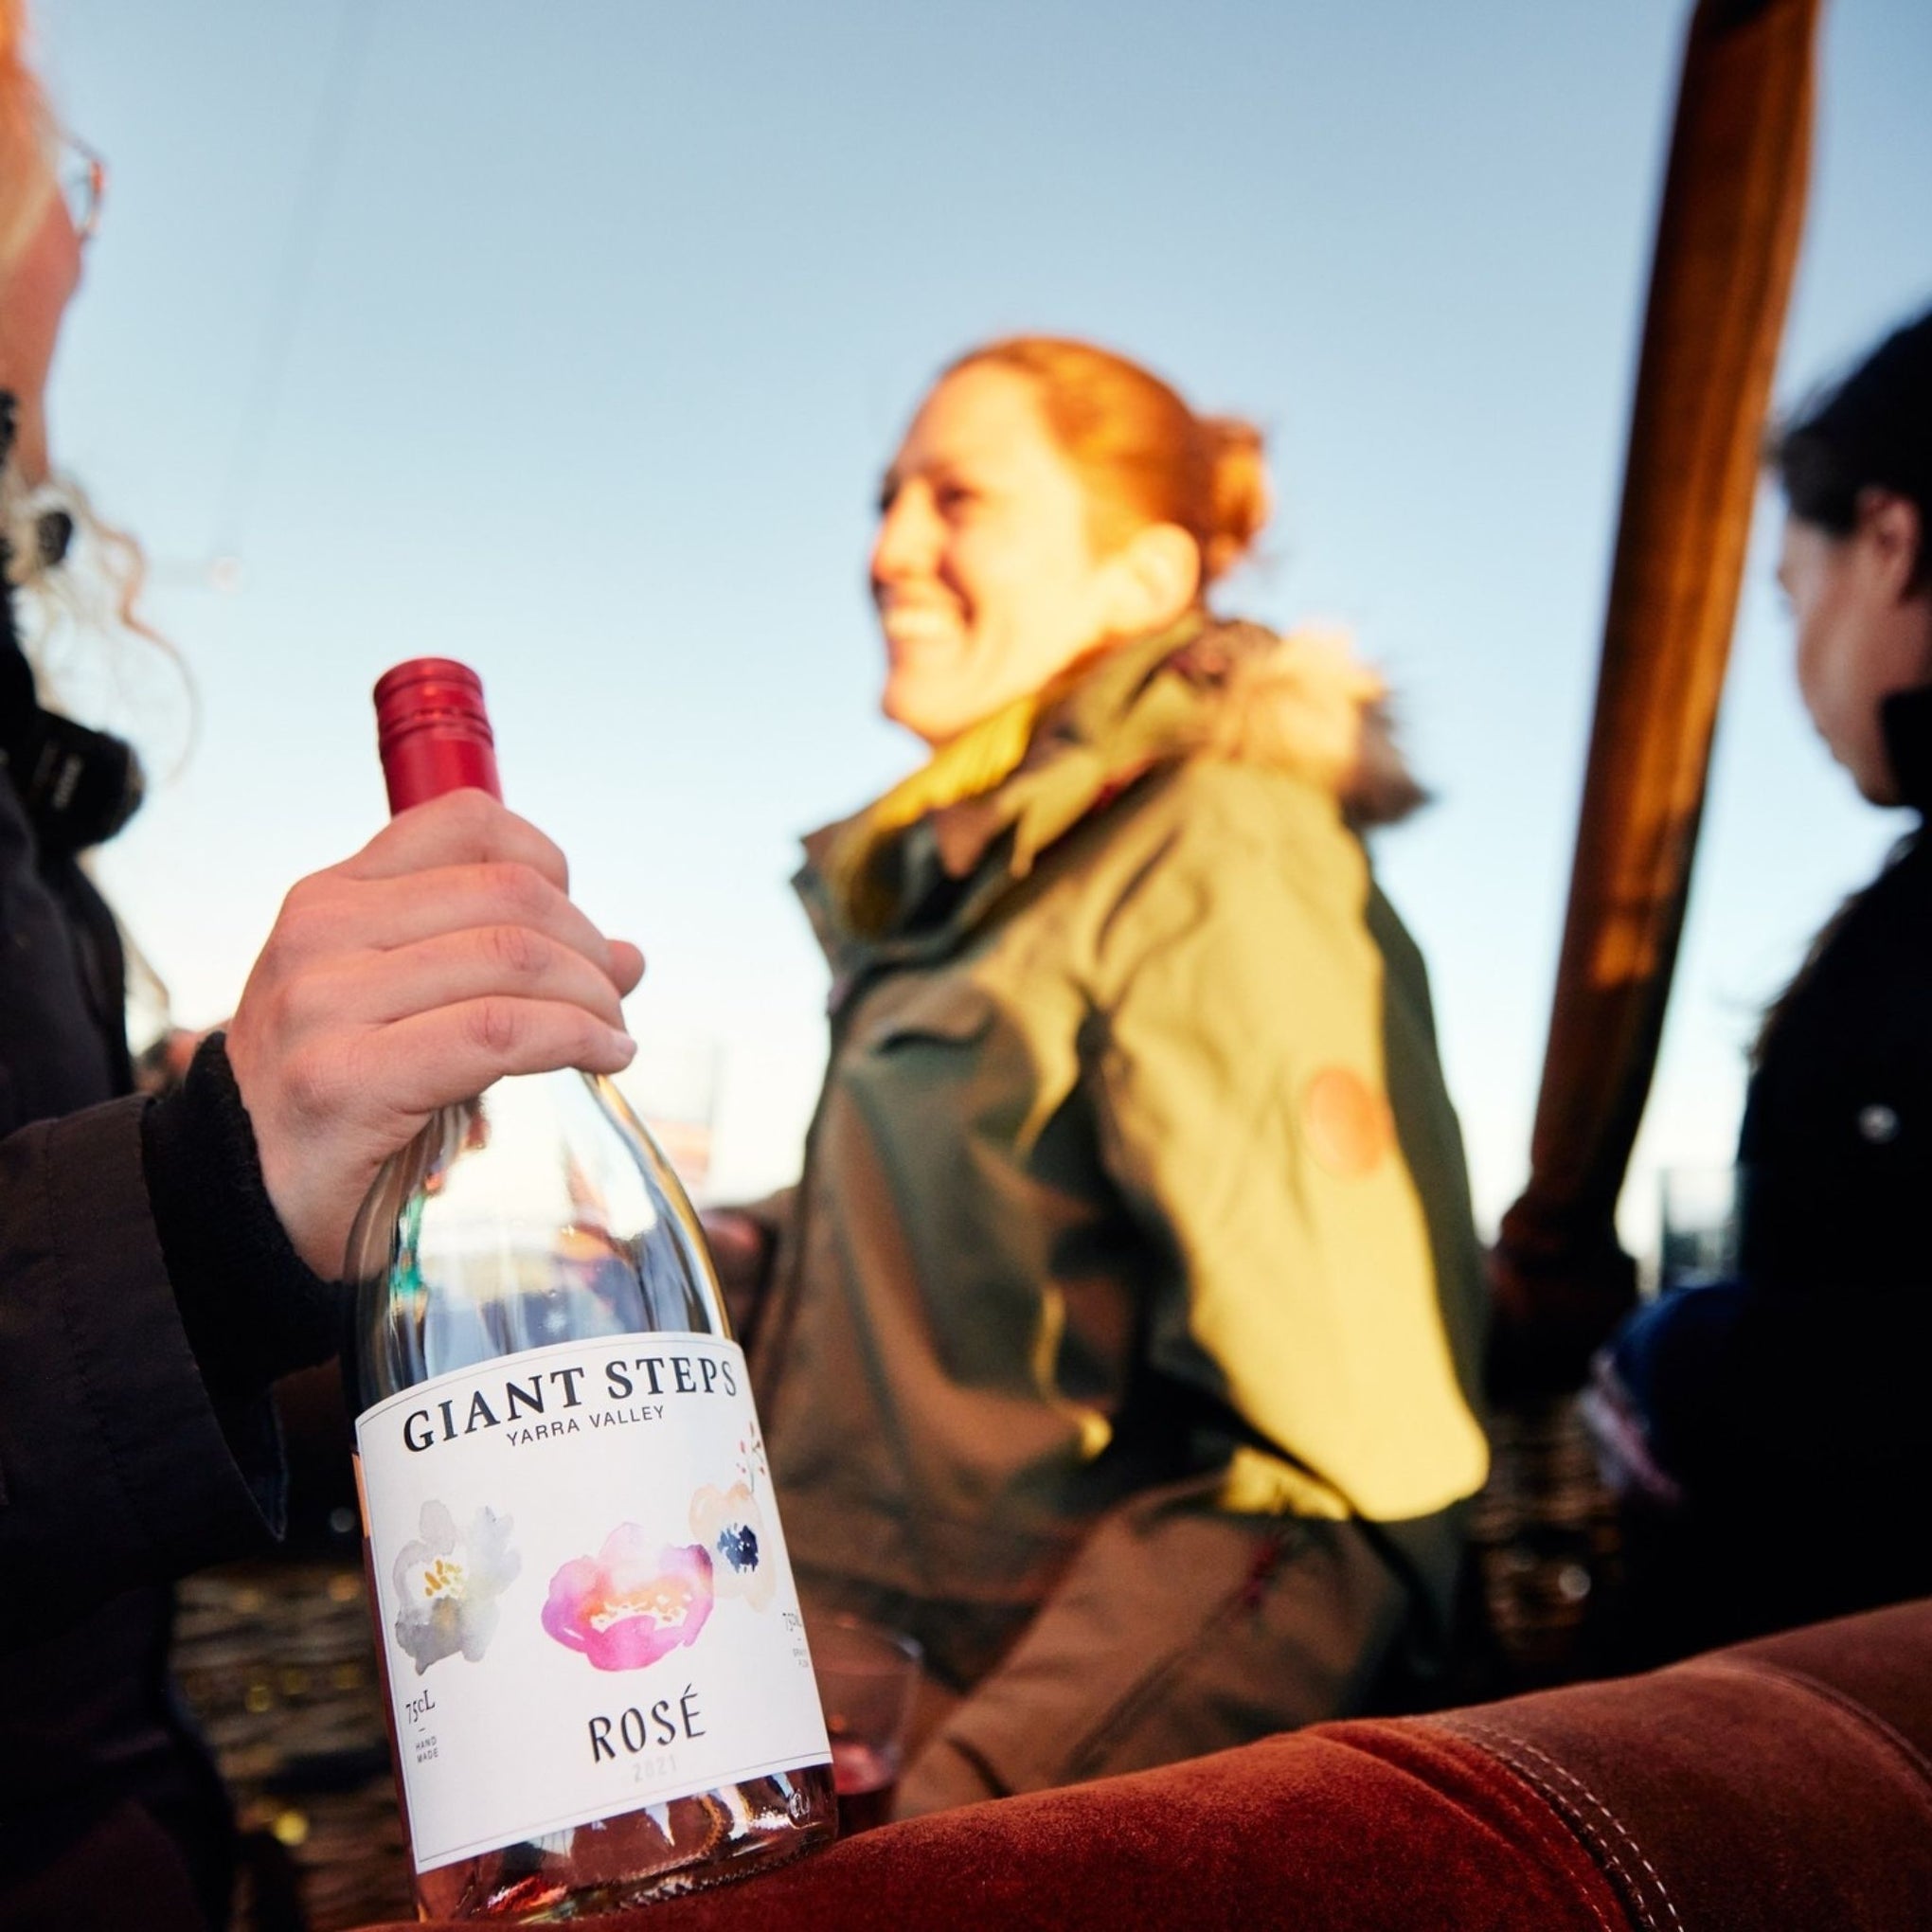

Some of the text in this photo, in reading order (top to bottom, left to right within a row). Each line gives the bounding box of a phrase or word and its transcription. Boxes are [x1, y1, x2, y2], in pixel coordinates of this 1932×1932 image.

[403, 1356, 738, 1453] GIANT STEPS
[507, 1404, 665, 1447] YARRA VALLEY
[405, 1689, 436, 1725] 75cL
[588, 1682, 707, 1764] ROSÉ
[416, 1736, 438, 1751] HAND
[417, 1748, 438, 1762] MADE
[632, 1754, 679, 1783] 2021
